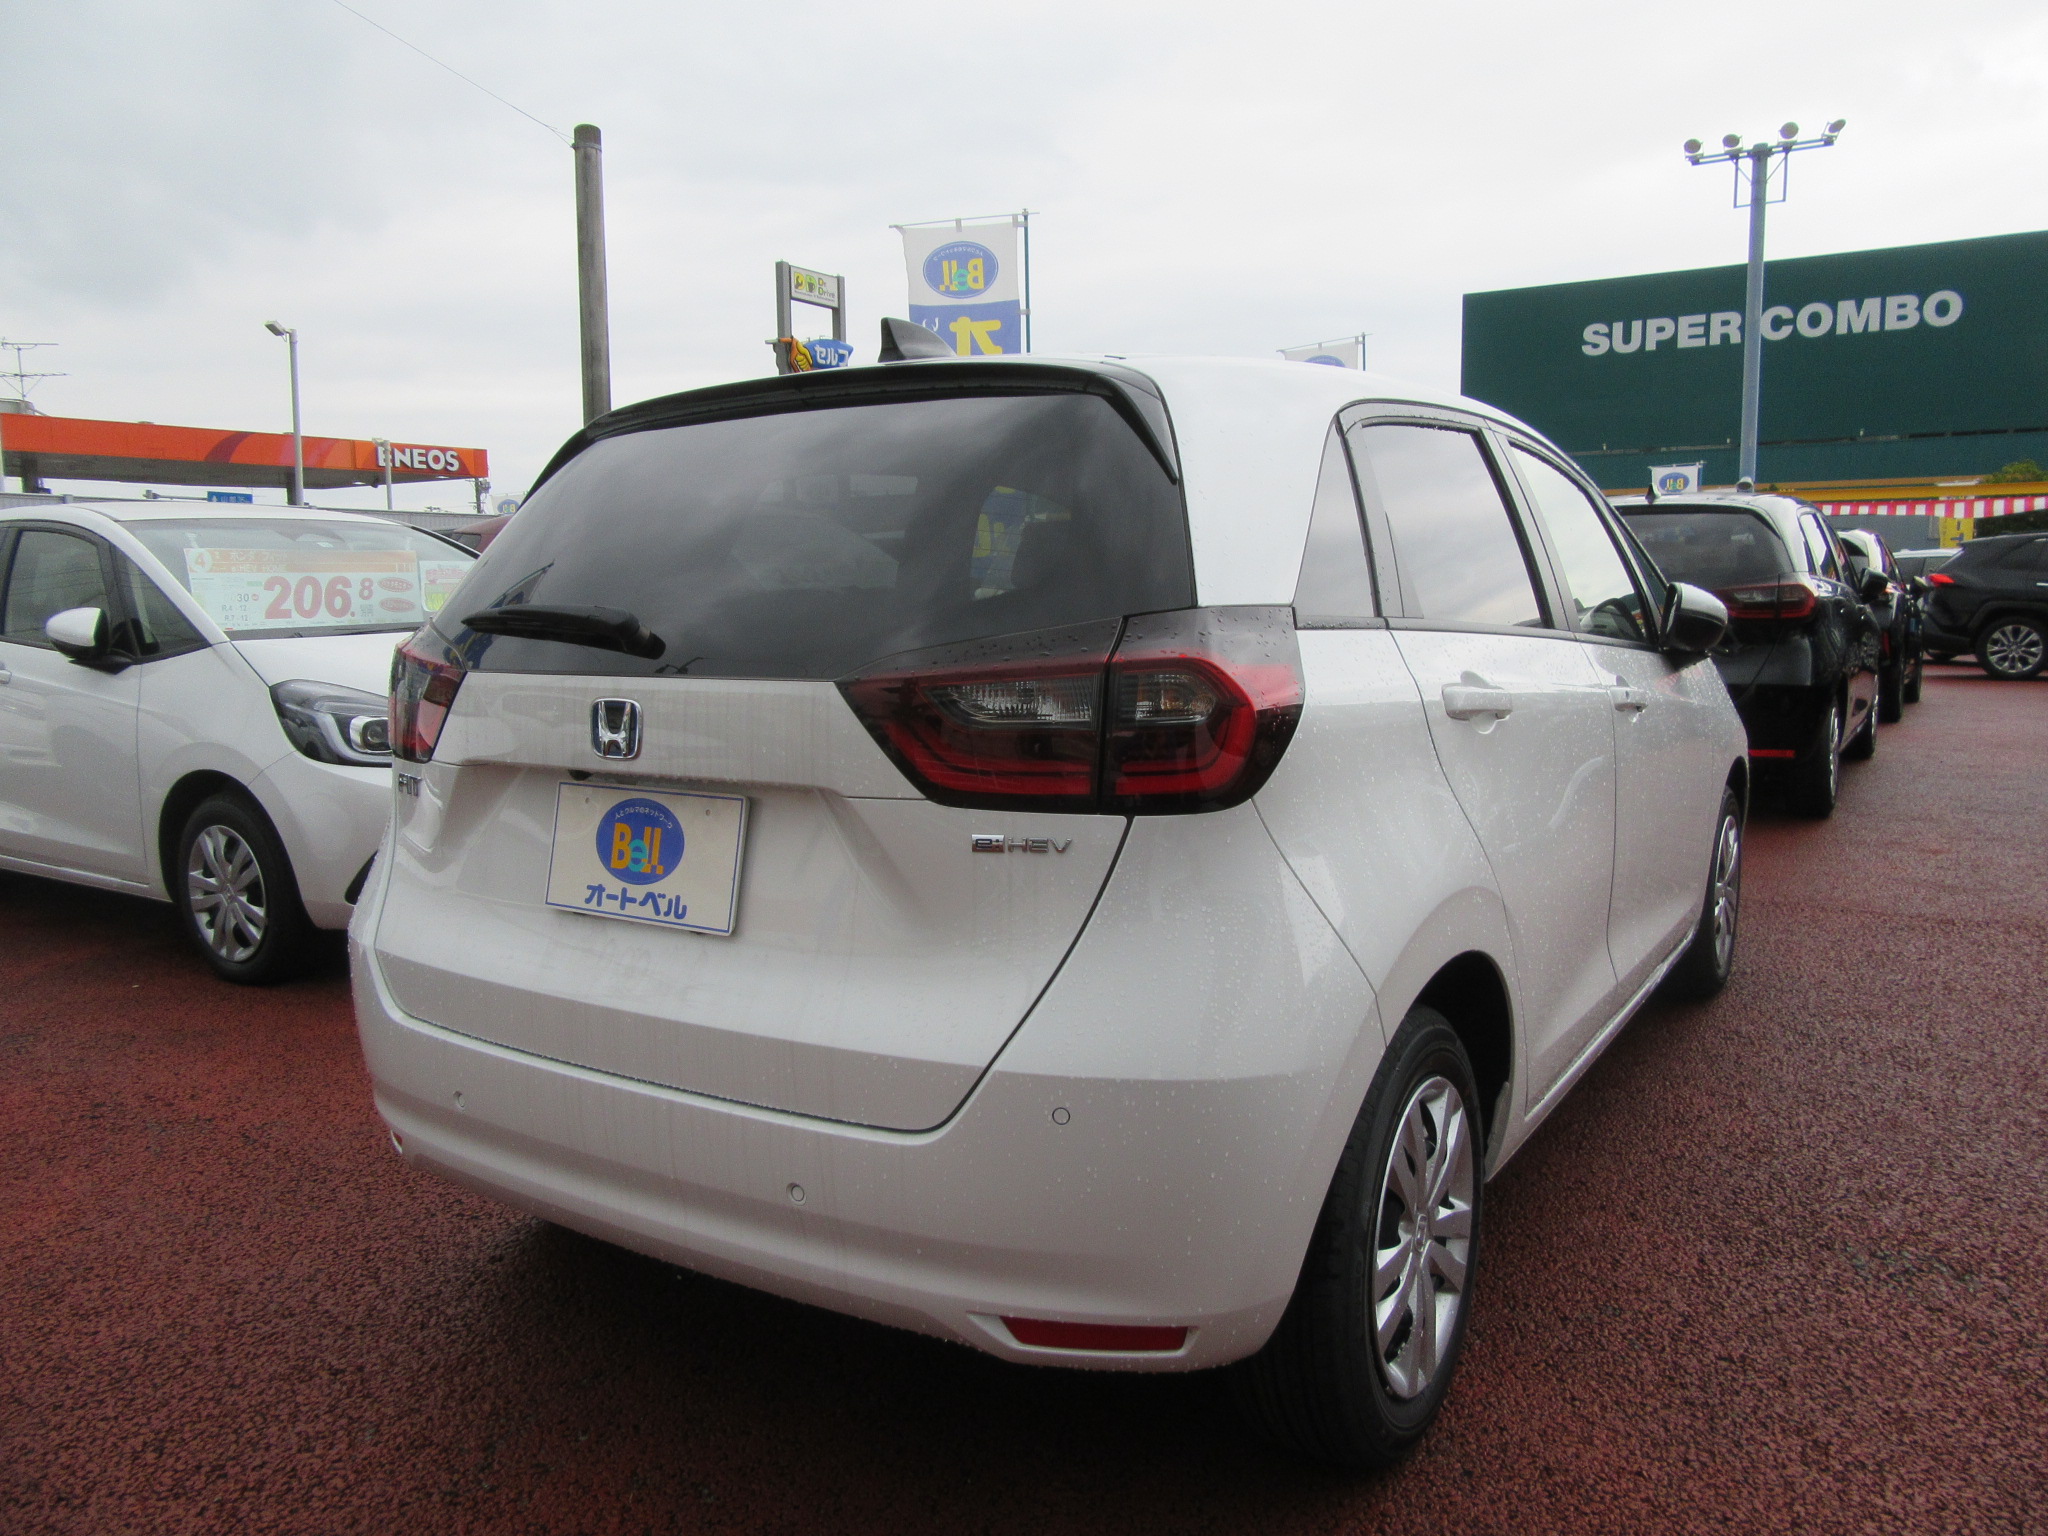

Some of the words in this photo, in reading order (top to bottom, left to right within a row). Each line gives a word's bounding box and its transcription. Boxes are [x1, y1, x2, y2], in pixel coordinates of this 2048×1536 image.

[1581, 311, 1742, 357] SUPER
[1760, 289, 1963, 341] COMBO
[377, 446, 460, 472] ENEOS
[236, 593, 250, 602] 30
[584, 883, 688, 920] オートベル
